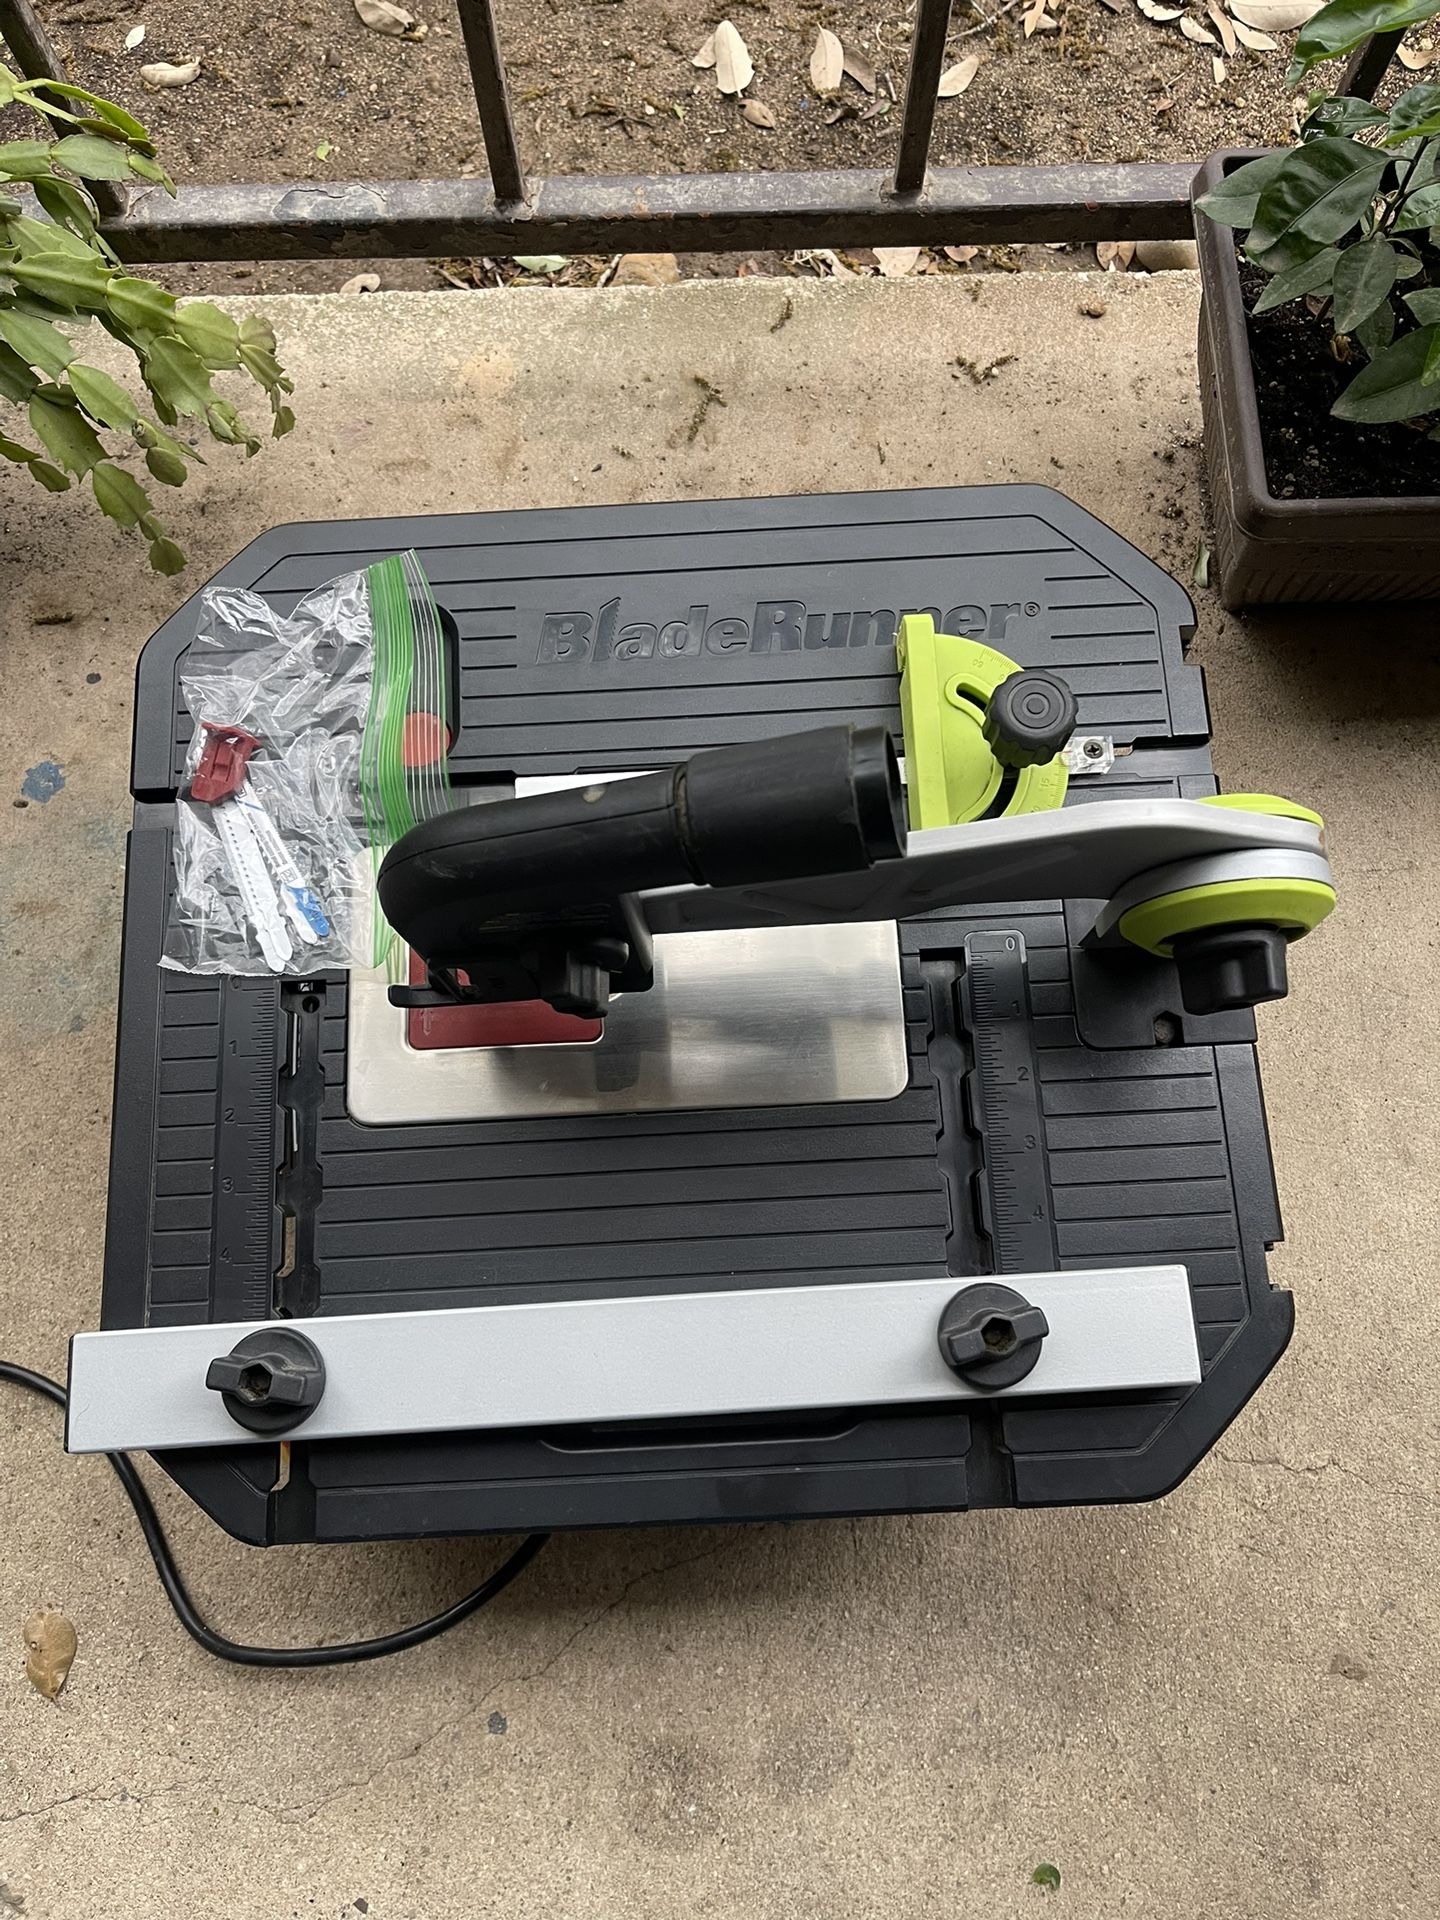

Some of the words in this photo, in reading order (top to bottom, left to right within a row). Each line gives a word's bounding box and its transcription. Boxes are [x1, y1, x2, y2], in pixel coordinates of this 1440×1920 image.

[1040, 777, 1050, 787] 15
[1005, 936, 1016, 951] 0
[1011, 1001, 1021, 1014] 1
[229, 1040, 238, 1054] 1
[1017, 1066, 1029, 1081] 2
[224, 1108, 235, 1122] 2
[1024, 1135, 1036, 1149] 3
[222, 1178, 234, 1192] 3
[1032, 1205, 1045, 1220] 4
[219, 1249, 231, 1263] 4
